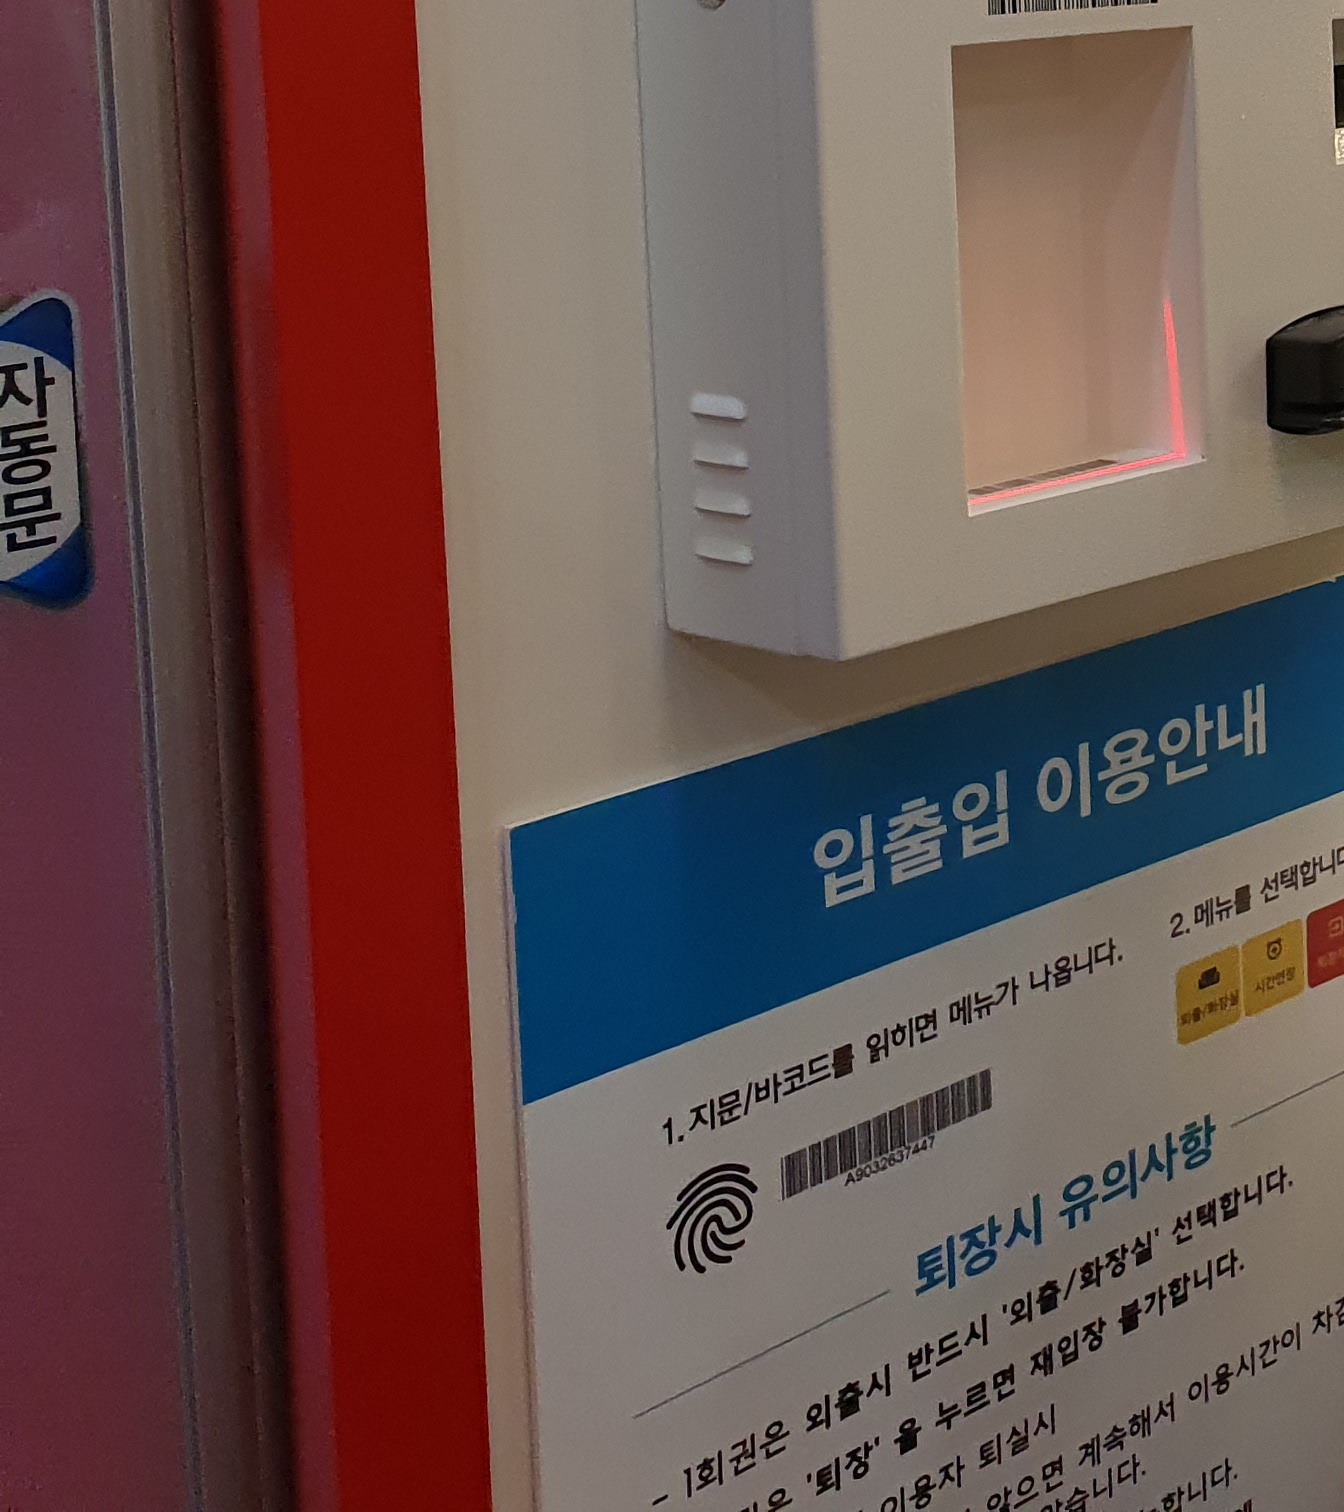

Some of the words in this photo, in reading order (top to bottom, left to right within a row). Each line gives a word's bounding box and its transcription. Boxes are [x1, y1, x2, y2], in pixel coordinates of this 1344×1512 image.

[0, 356, 62, 552] 자동문
[813, 769, 1010, 908] 입출입
[1036, 683, 1268, 818] 이용안내
[866, 1009, 938, 1064] 읽히면
[948, 977, 1019, 1026] 메뉴가
[1029, 938, 1124, 992] 나옵니다.
[915, 1193, 1043, 1296] 퇴장시
[1059, 1114, 1217, 1230] 유의사항
[684, 1420, 790, 1498] 1회권은
[806, 1363, 892, 1432] 외출시
[908, 1314, 989, 1382] 반드시
[1172, 1165, 1294, 1246] 선택합니다.
[935, 1363, 1016, 1431] 누르면
[1030, 1317, 1106, 1377] 재입장
[1118, 1248, 1245, 1335] 불가합니다.
[1078, 1392, 1175, 1467] 계속해서
[1188, 1322, 1300, 1404] 이용시간이
[880, 1455, 965, 1512] 이용자
[979, 1403, 1056, 1470] 퇴실시
